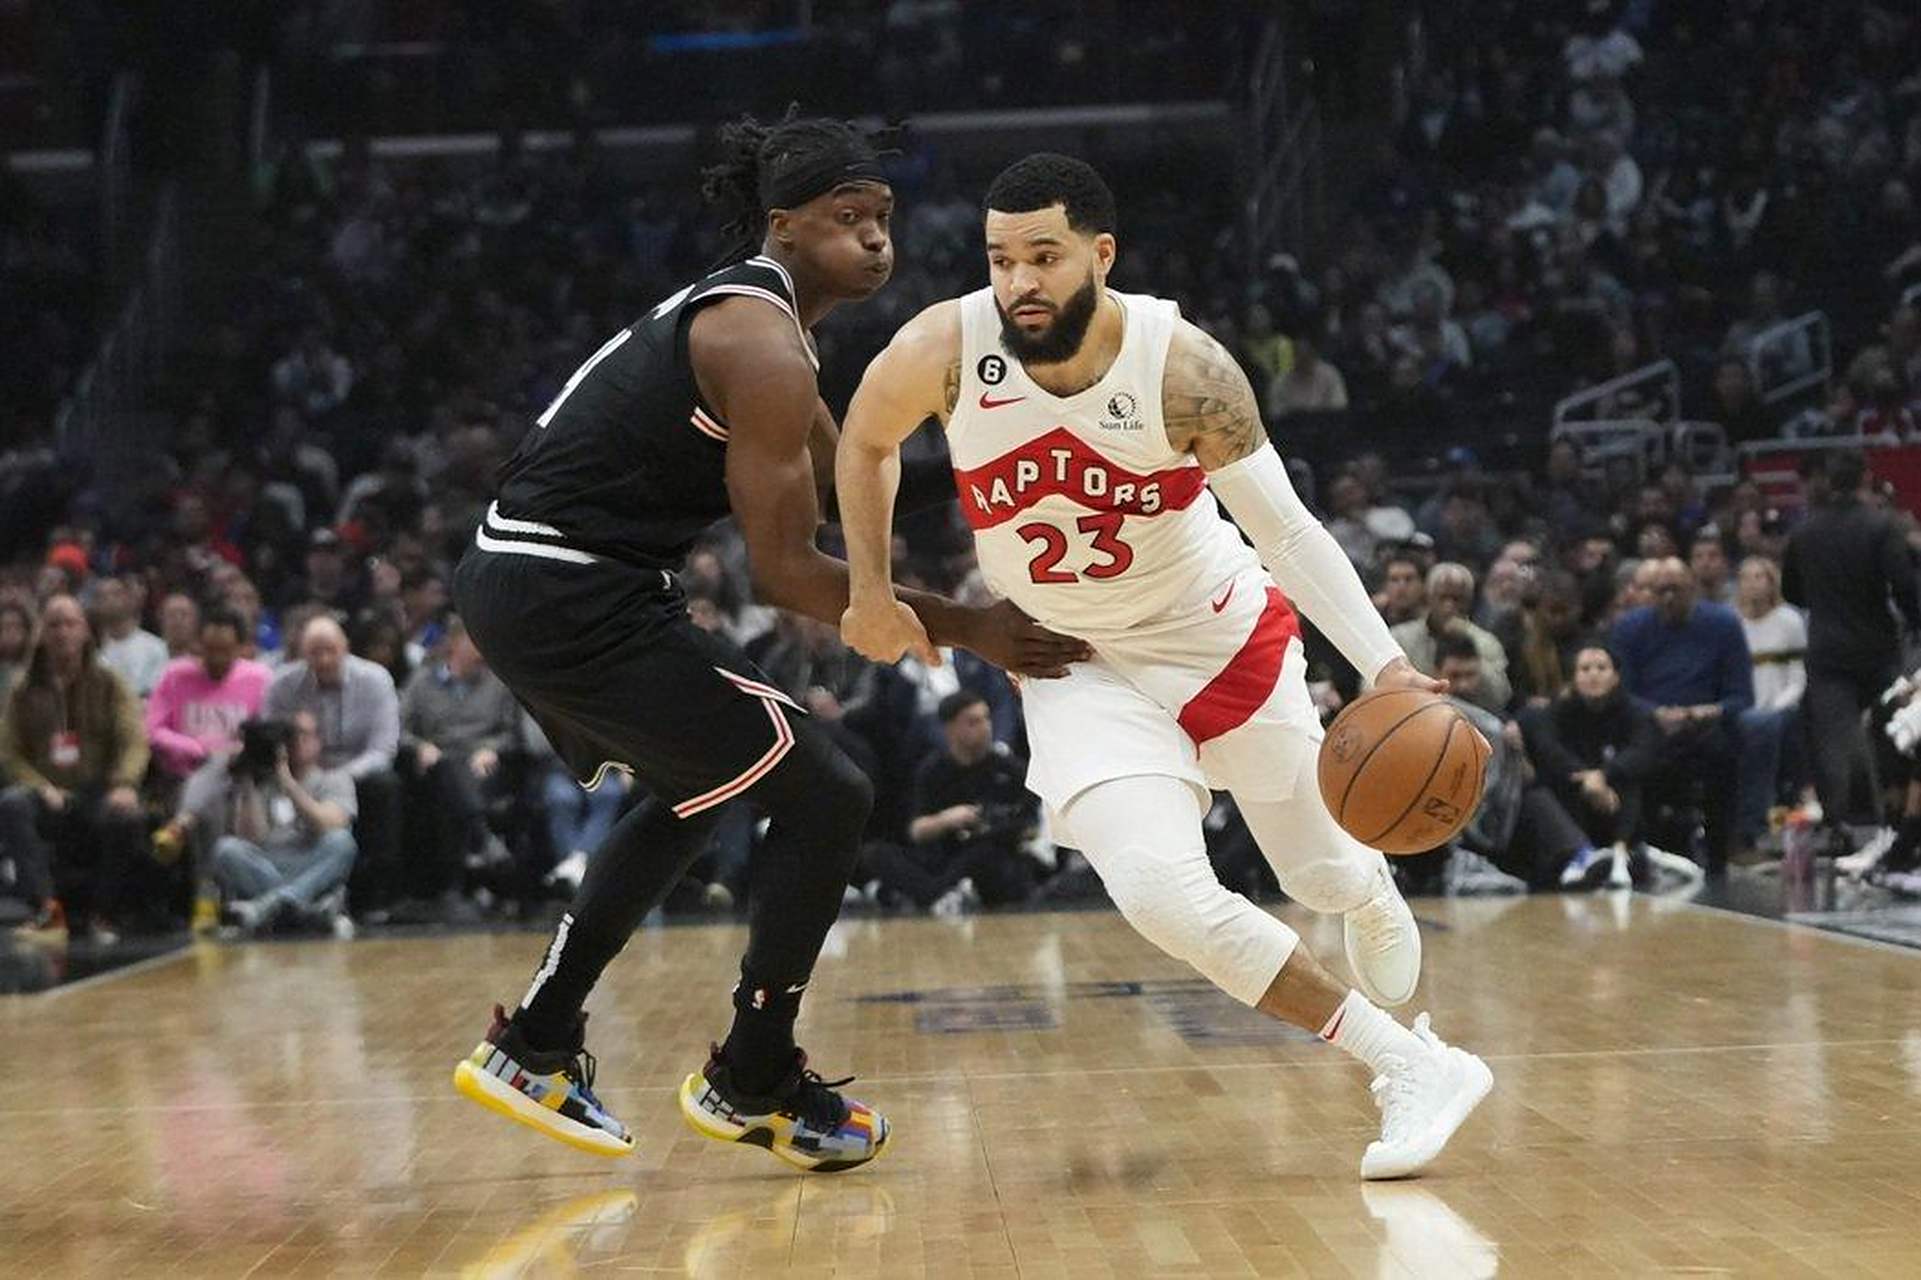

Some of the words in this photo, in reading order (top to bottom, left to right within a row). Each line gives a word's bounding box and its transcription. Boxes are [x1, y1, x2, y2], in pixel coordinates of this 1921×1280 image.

[984, 358, 1001, 382] 6
[1099, 420, 1122, 431] Sun
[1123, 419, 1144, 431] Life
[970, 448, 1162, 514] RAPTORS
[1015, 510, 1134, 584] 23
